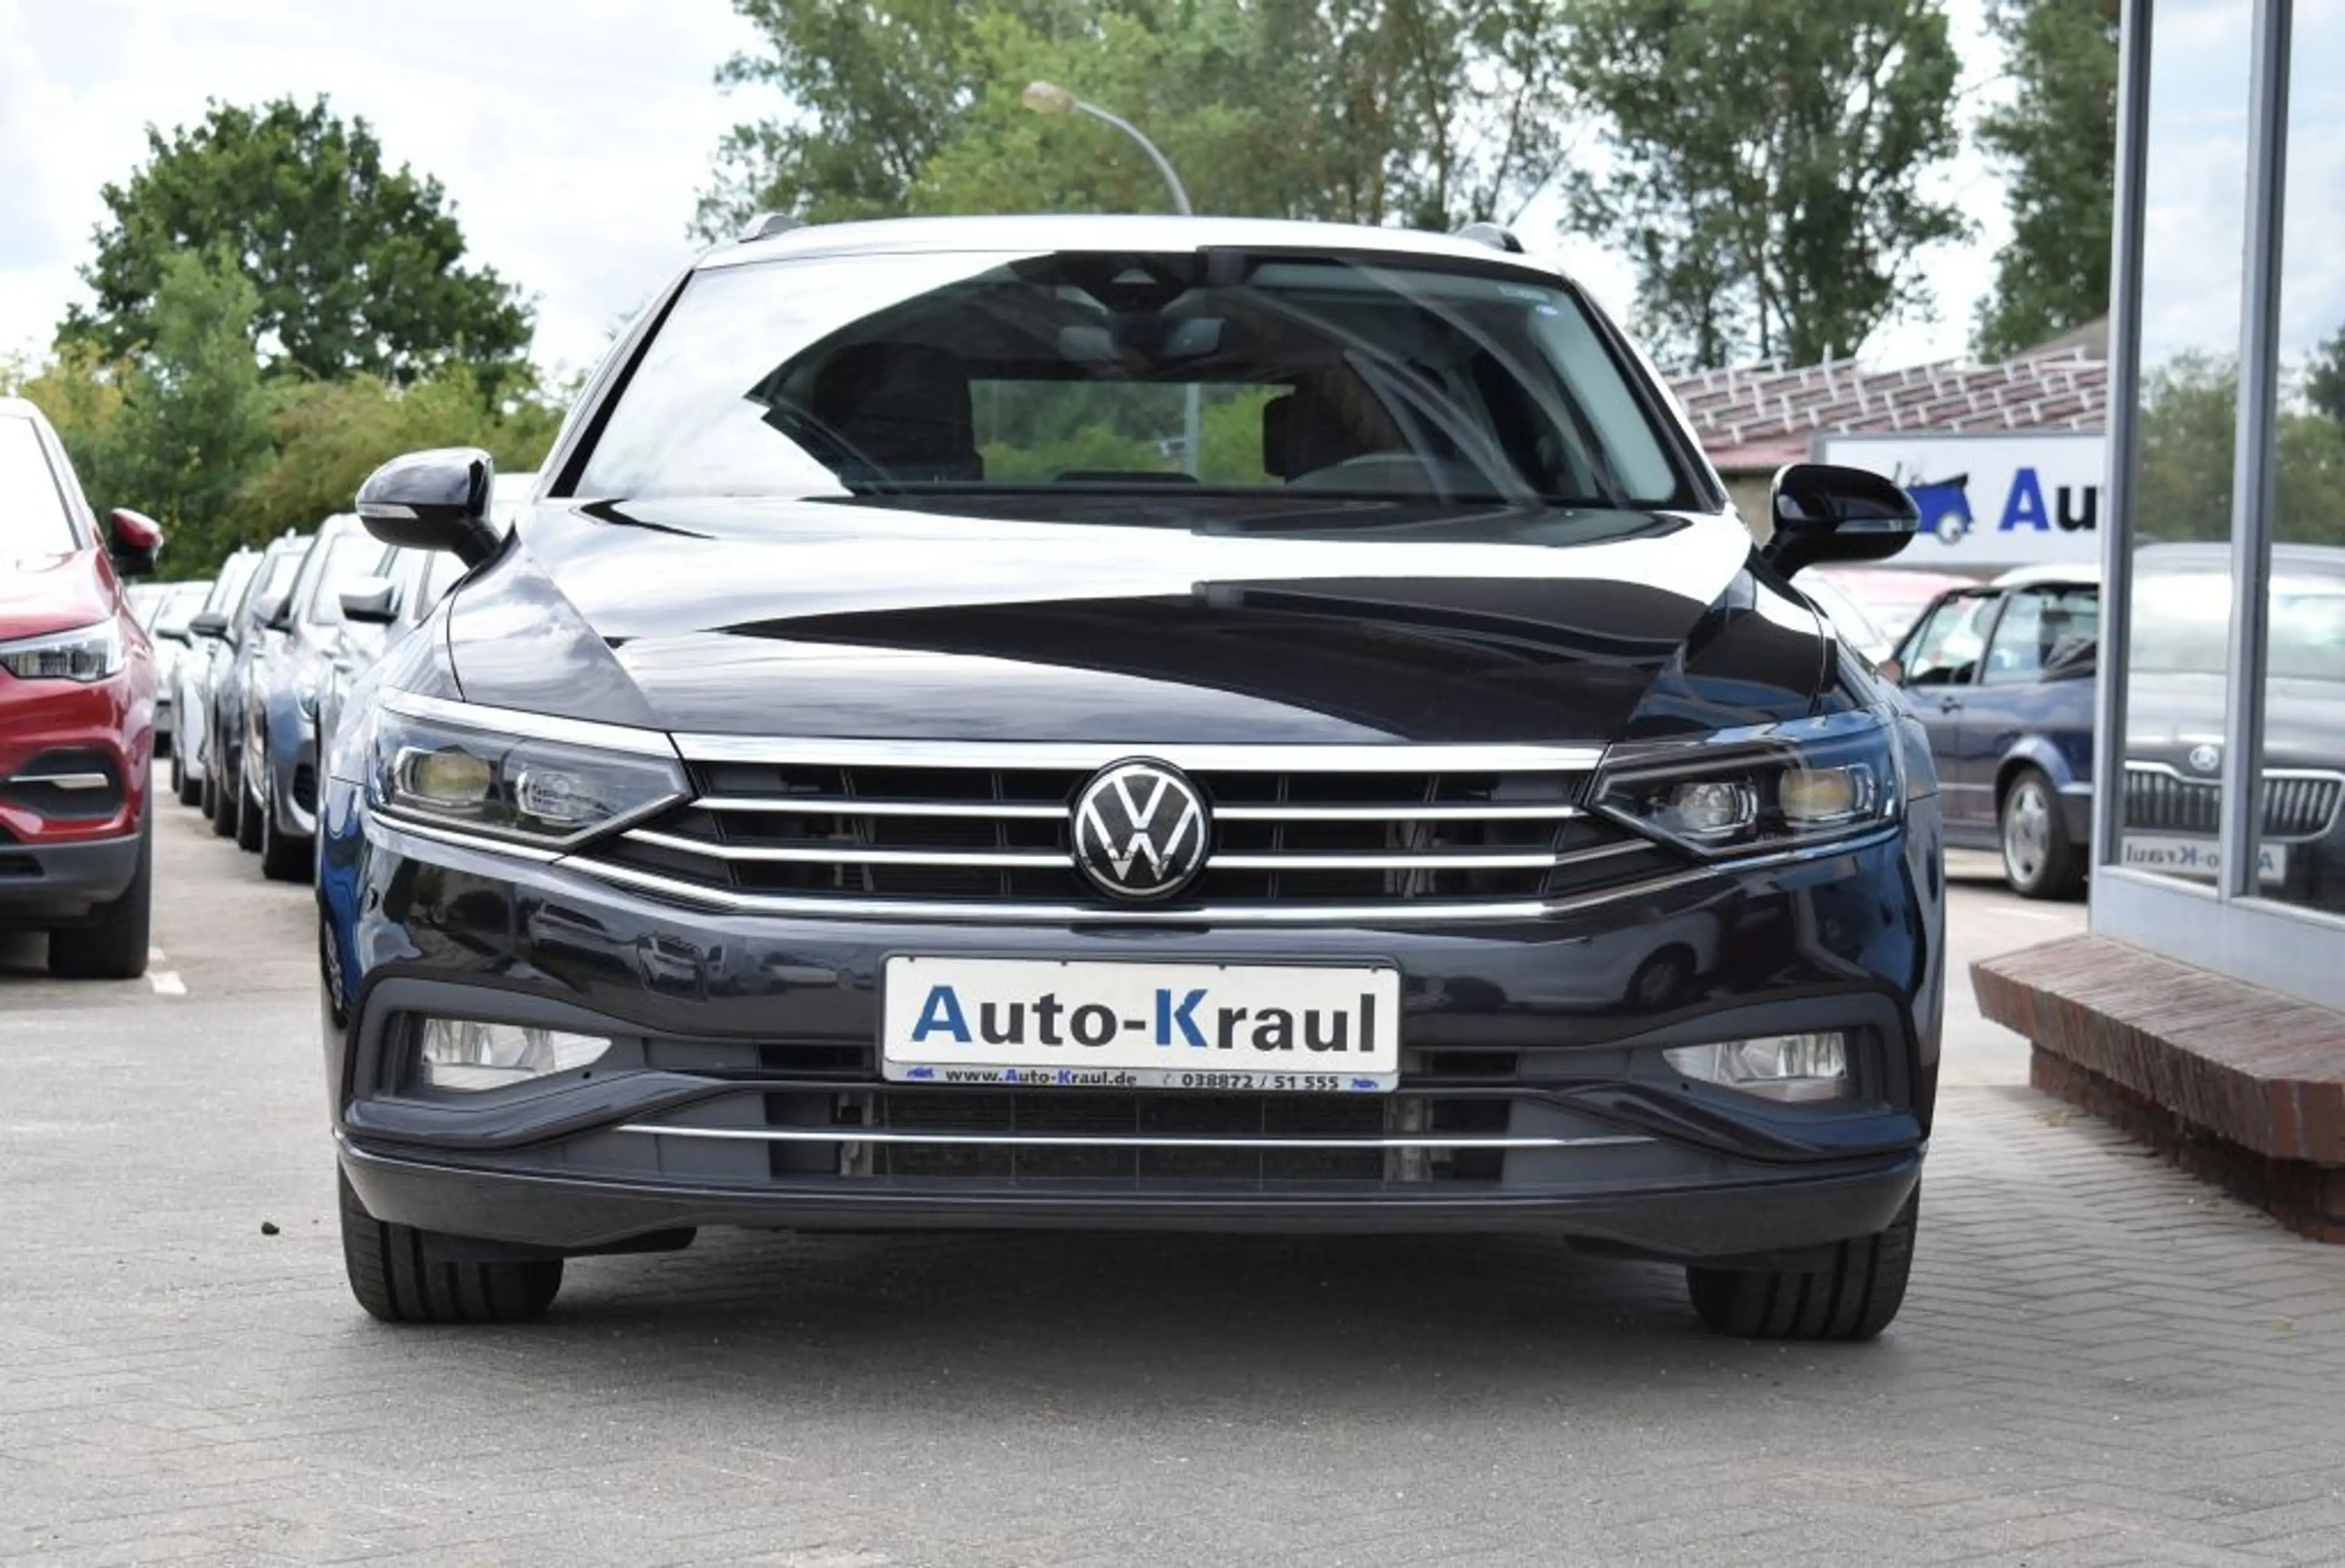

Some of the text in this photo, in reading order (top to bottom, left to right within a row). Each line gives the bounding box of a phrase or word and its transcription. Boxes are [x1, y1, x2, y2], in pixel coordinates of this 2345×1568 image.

[1998, 467, 2103, 532] Au
[1080, 768, 1201, 890] VW
[911, 984, 1376, 1053] Auto-Kraul
[945, 1068, 1137, 1086] www.Auto-Kraul.de
[1181, 1073, 1254, 1088] 038872
[1274, 1075, 1296, 1089] 51
[1304, 1075, 1339, 1089] 555
